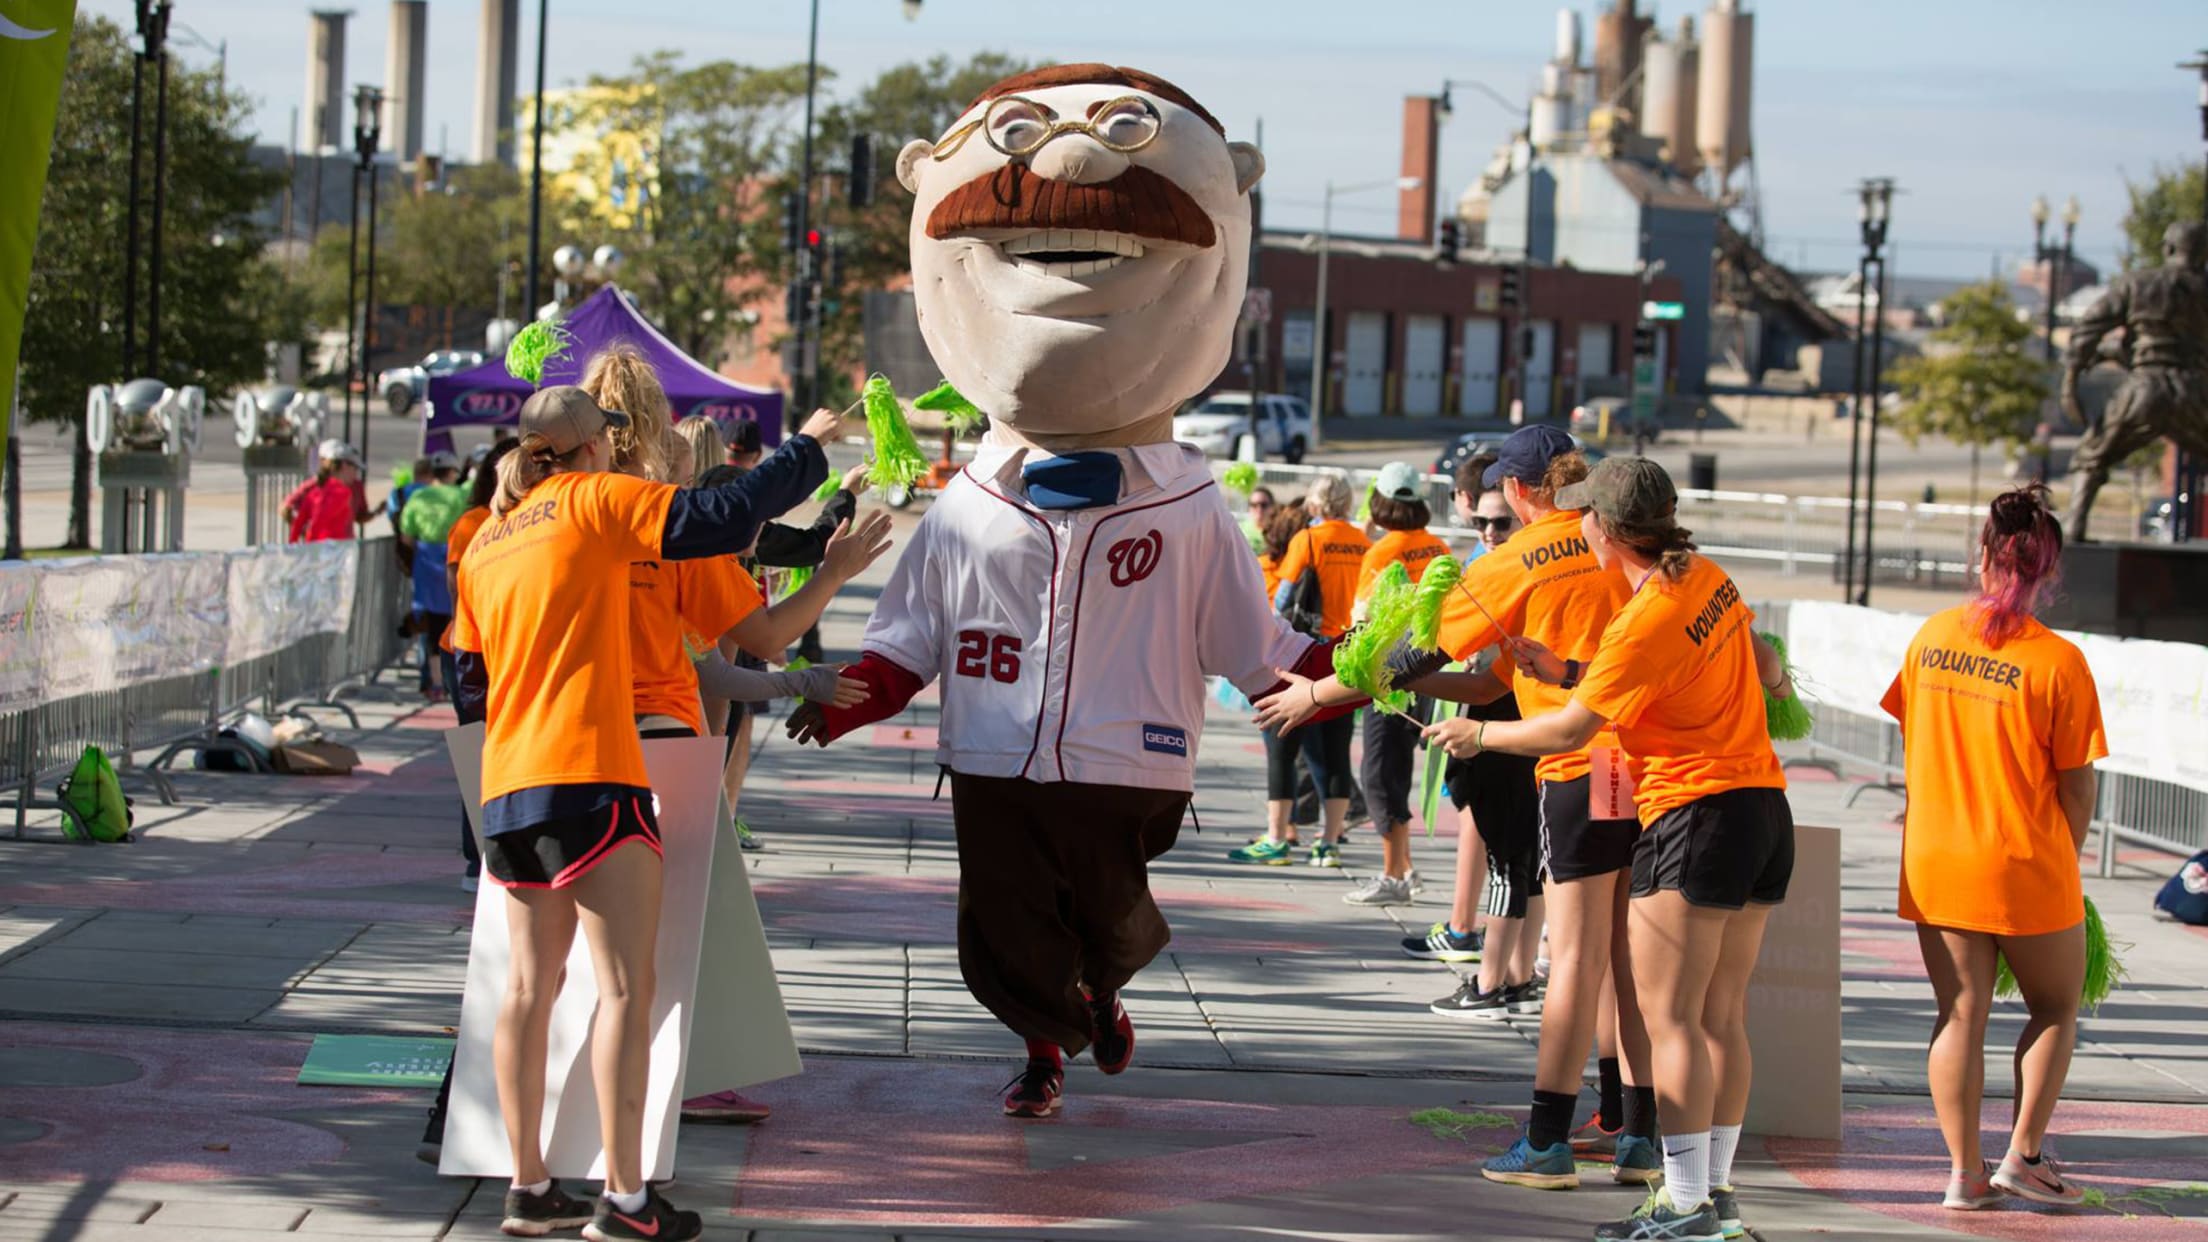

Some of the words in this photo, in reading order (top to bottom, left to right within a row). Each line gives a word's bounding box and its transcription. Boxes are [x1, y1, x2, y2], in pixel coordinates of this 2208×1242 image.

[1106, 528, 1163, 588] W
[1521, 536, 1589, 571] VOLUN
[1684, 577, 1740, 647] VOLUNTEE
[956, 629, 1022, 684] 26
[1921, 646, 2022, 691] VOLUNTEER
[1145, 731, 1185, 748] GEICO
[1609, 748, 1620, 818] VOLUNTEER
